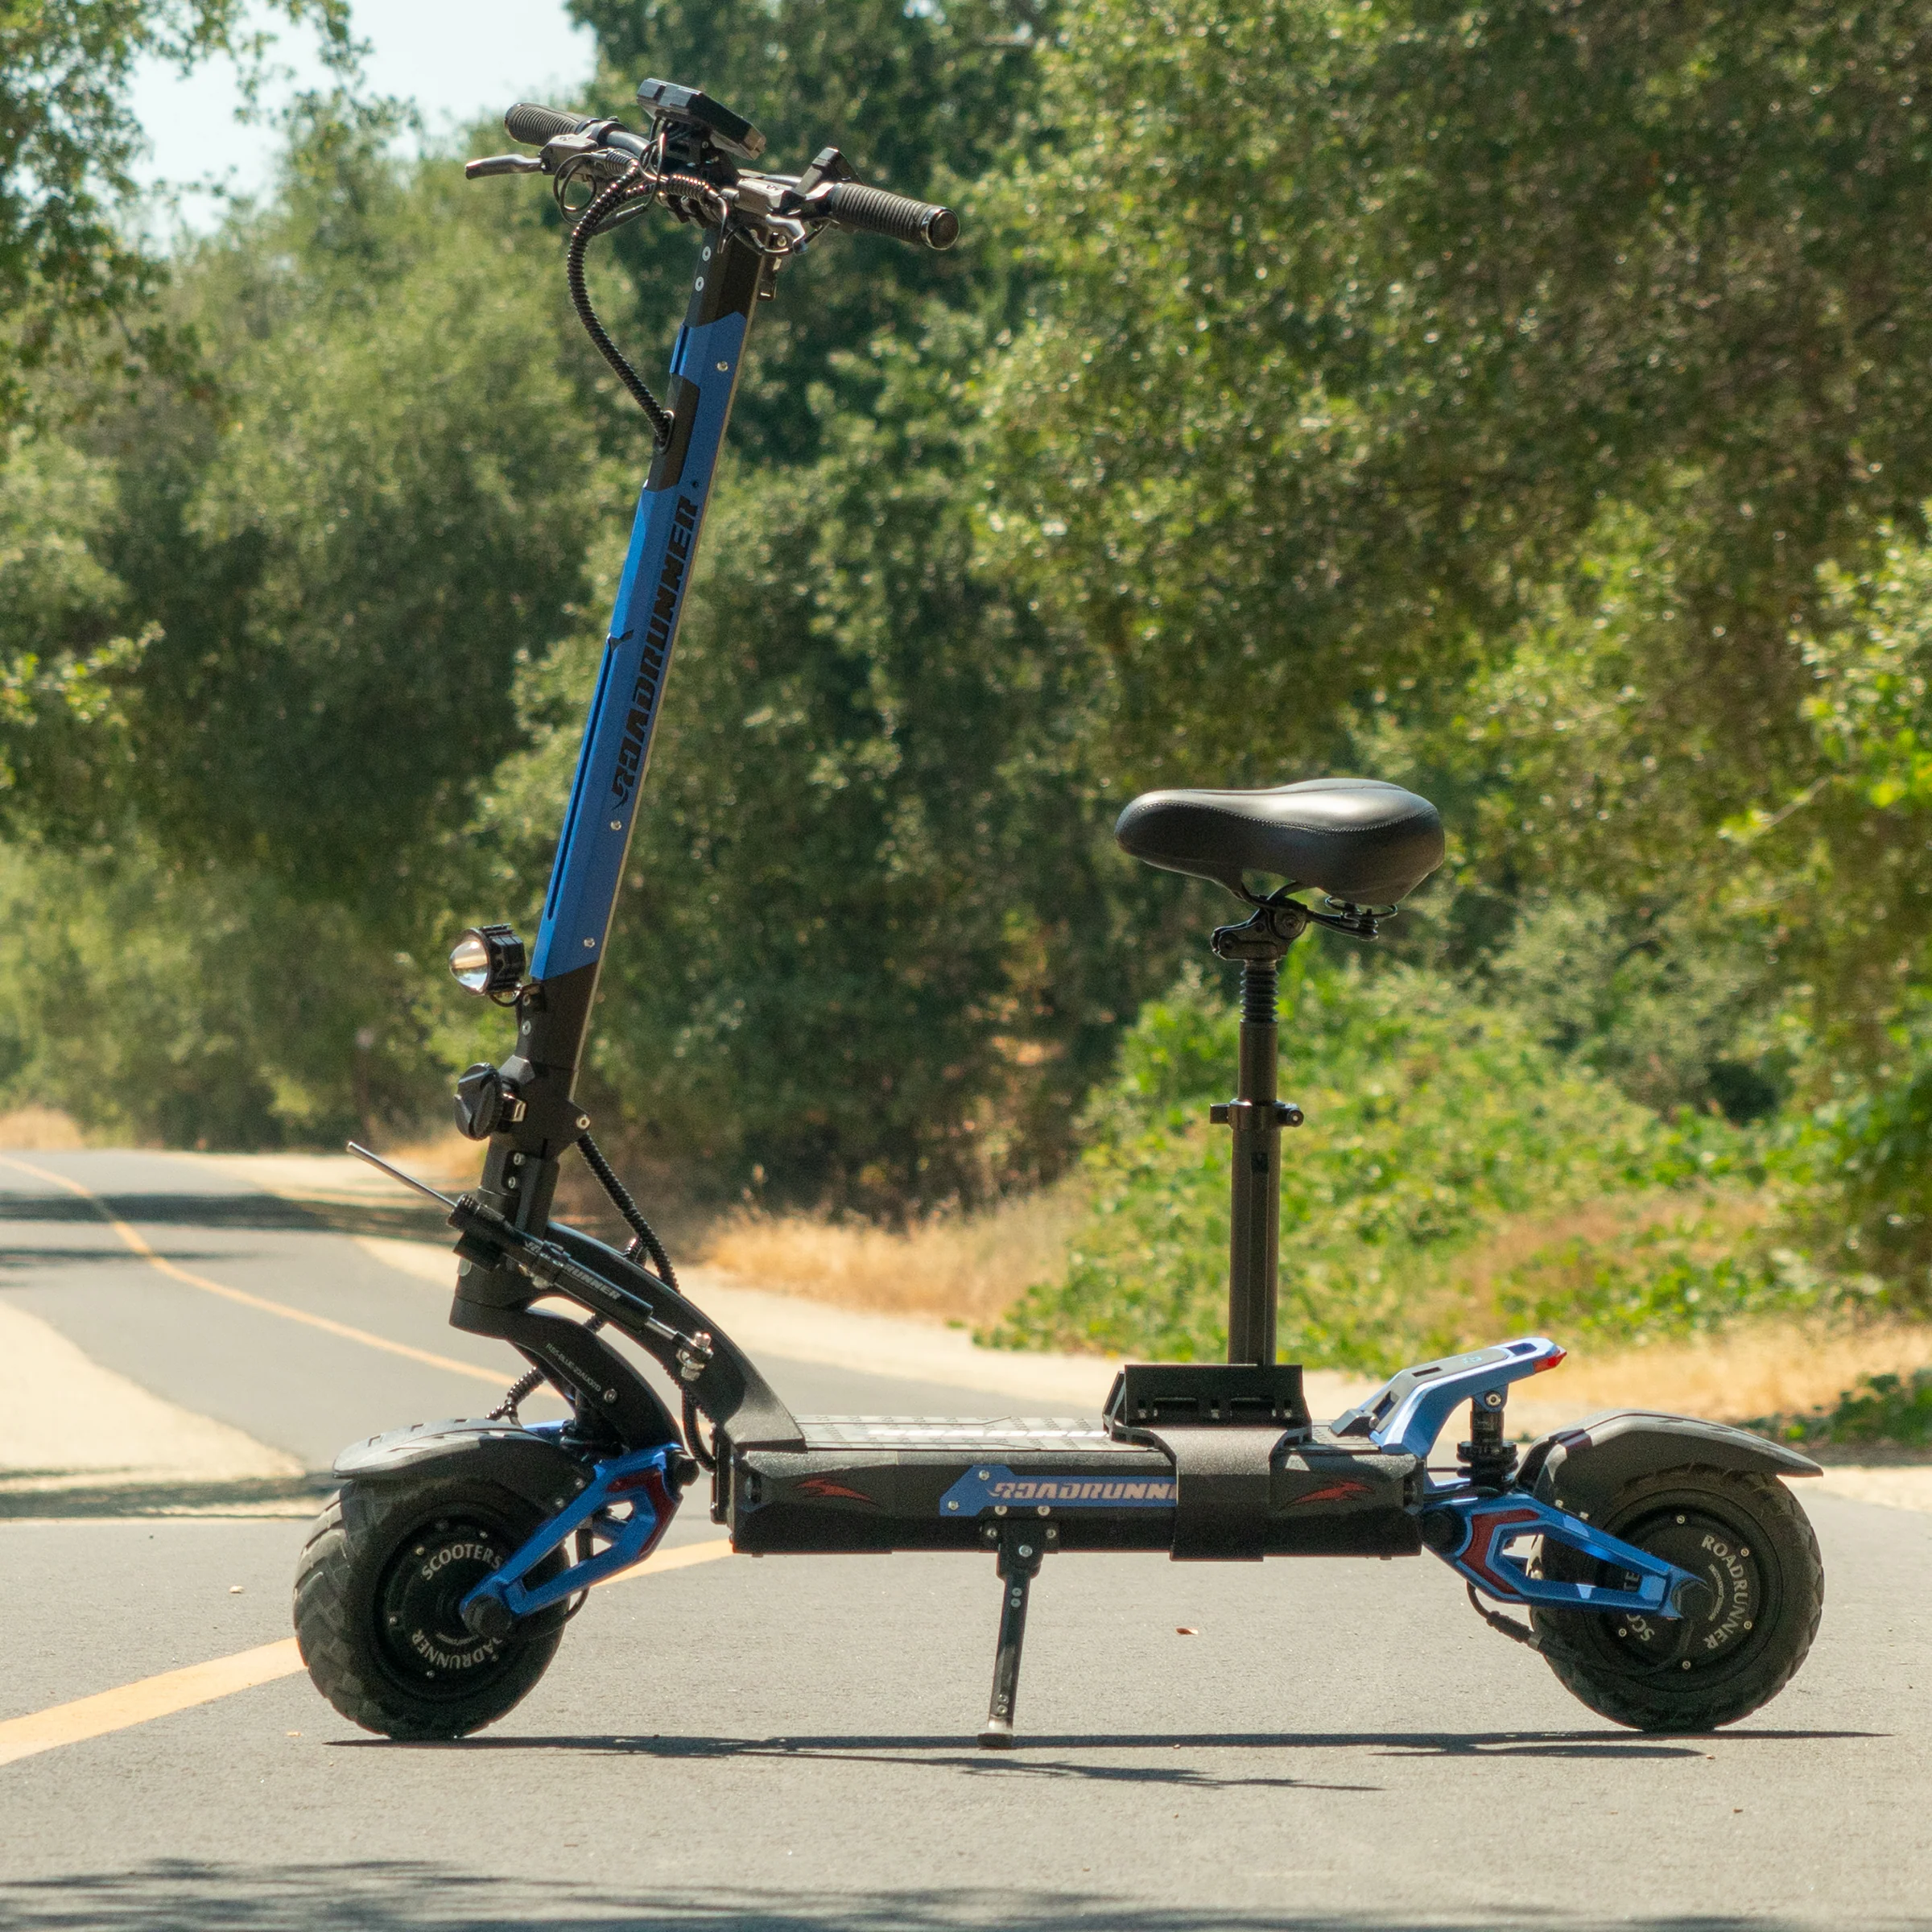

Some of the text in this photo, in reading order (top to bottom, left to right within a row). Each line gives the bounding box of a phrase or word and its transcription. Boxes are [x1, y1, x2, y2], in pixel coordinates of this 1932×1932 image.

[612, 495, 698, 810] ROADRUNNER
[525, 1241, 621, 1300] RRUNNER
[421, 1543, 503, 1581] SCOOTERS
[1701, 1534, 1748, 1649] ROADRUNNER
[411, 1629, 503, 1670] ADRUNNER
